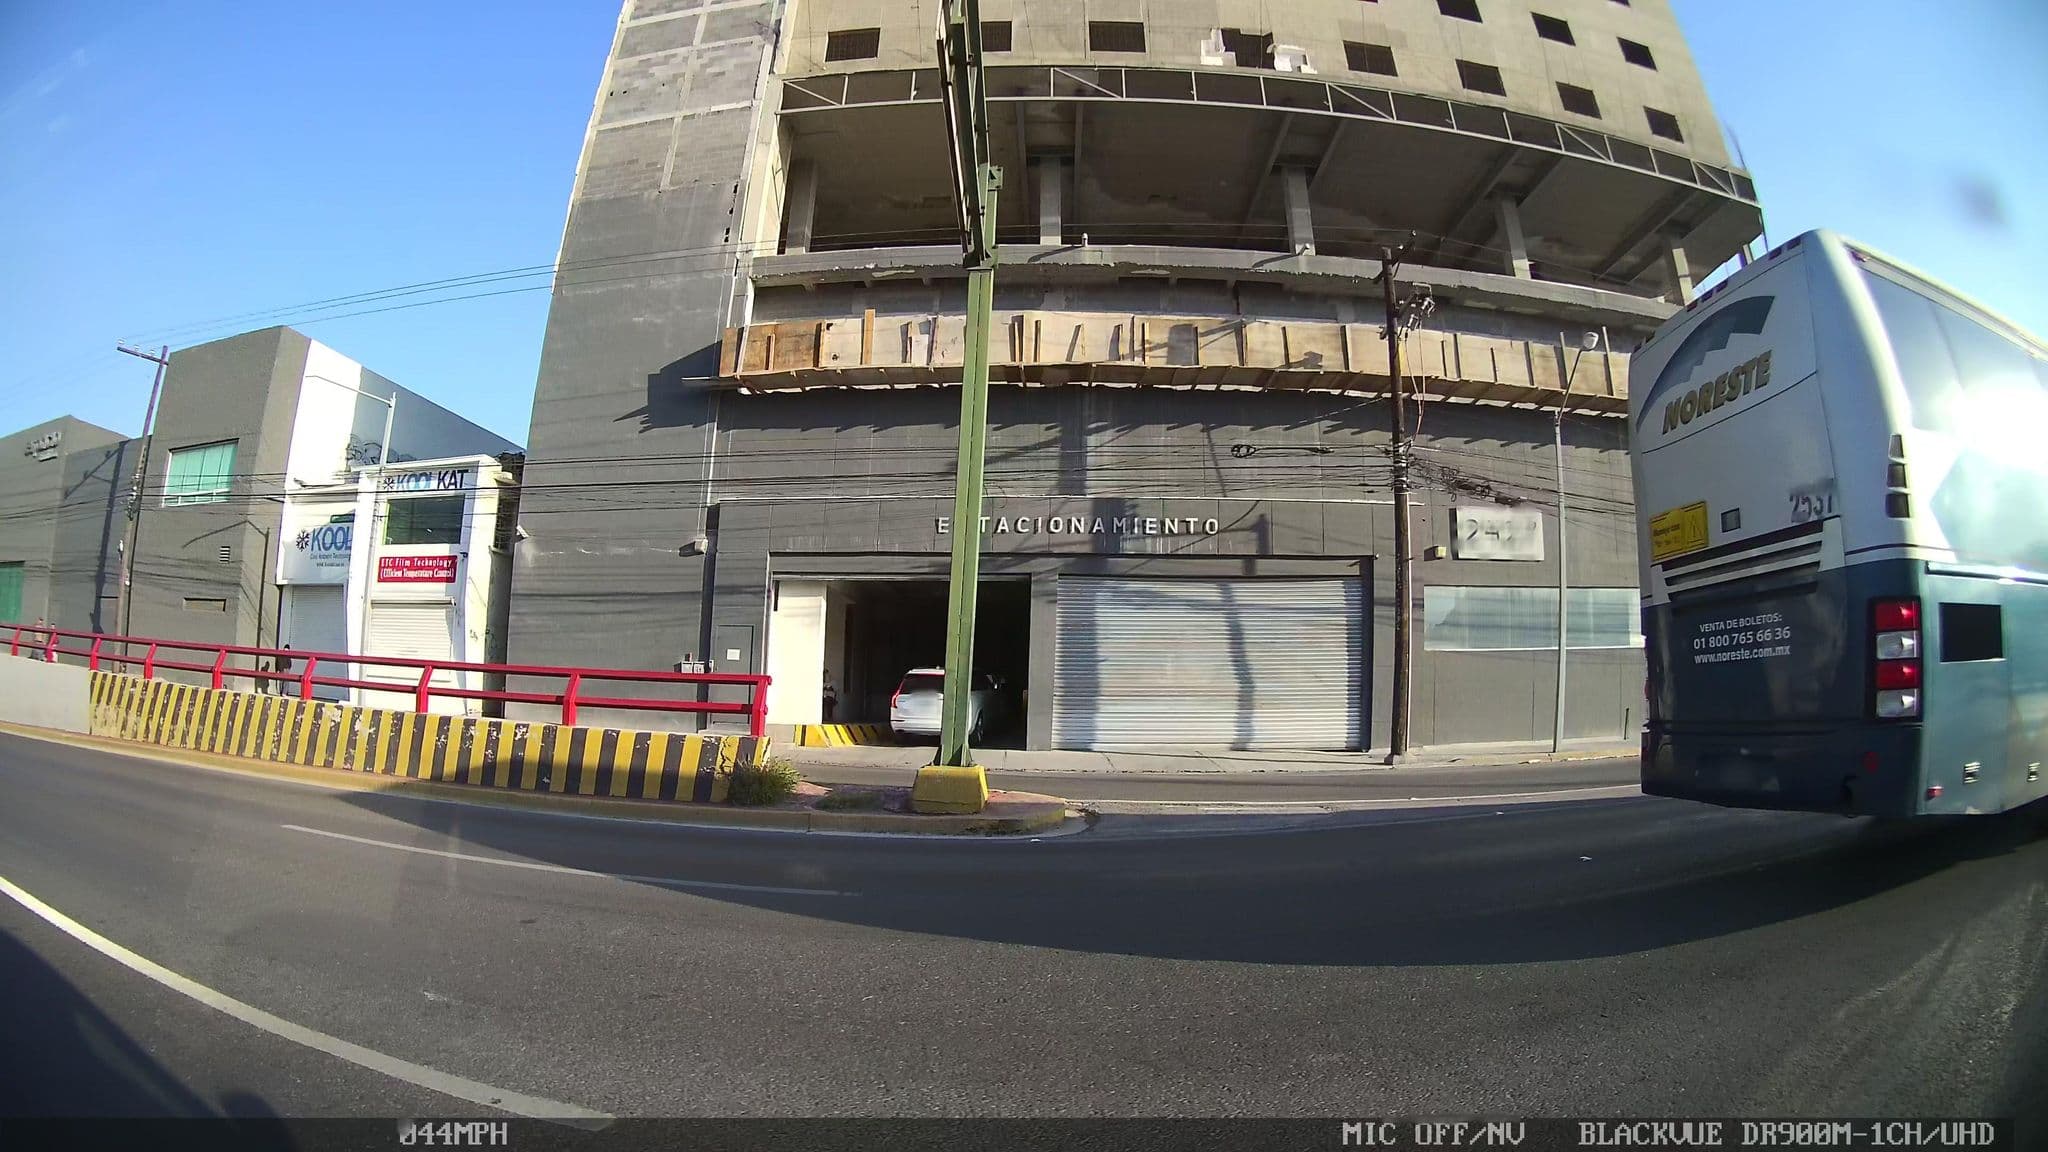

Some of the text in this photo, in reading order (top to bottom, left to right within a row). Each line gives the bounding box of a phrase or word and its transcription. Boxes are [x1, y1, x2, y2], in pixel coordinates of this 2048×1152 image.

[1662, 350, 1772, 435] NORESTE
[936, 515, 1220, 535] ETACIONAMIENTO
[1699, 612, 1783, 633] VENTA DE BOLETOS:
[1693, 626, 1791, 649] 01 800 765 66 36
[1694, 645, 1791, 664] www.noreste.com.mx
